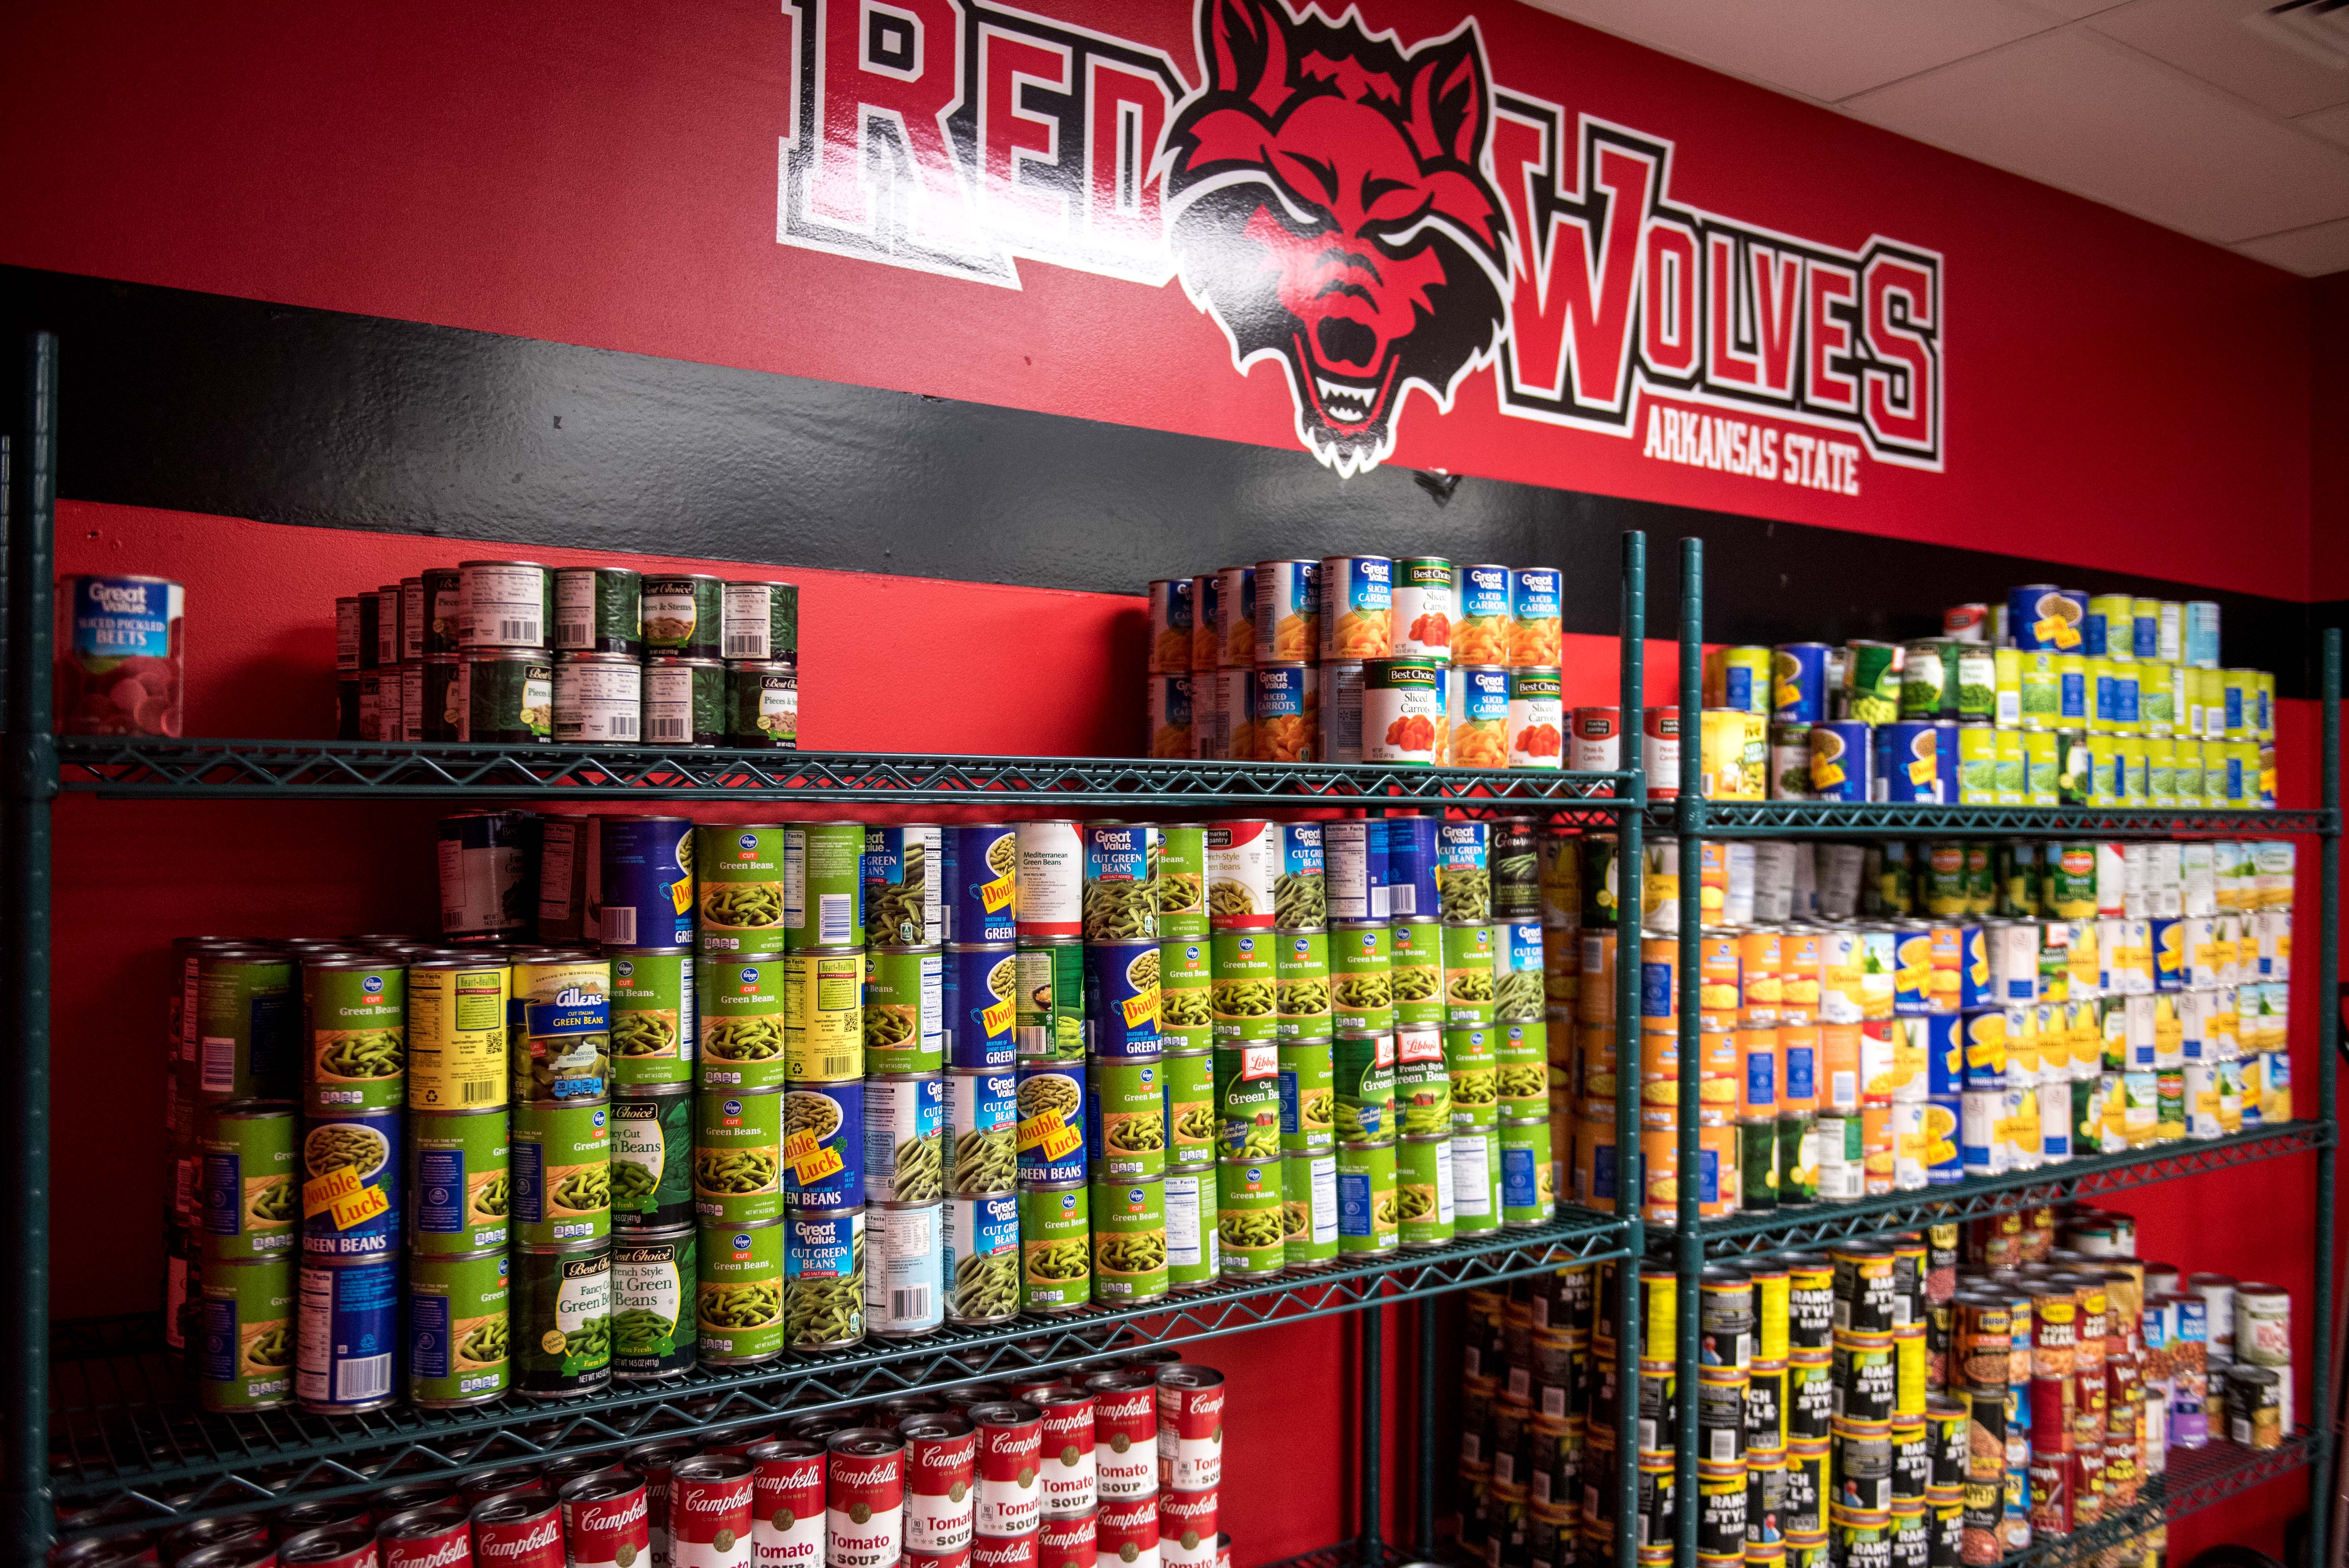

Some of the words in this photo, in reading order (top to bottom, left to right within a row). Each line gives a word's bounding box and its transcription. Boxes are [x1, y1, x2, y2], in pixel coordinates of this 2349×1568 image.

[778, 0, 1174, 289] RED
[1488, 87, 1944, 471] WOLVES
[1644, 404, 1777, 480] ARKANSAS
[1783, 433, 1859, 496] STATE
[1413, 570, 1431, 579] Best
[1471, 571, 1502, 582] Great
[1522, 574, 1552, 586] Great
[659, 582, 692, 594] Choice
[1479, 580, 1502, 590] Value
[1530, 583, 1552, 592] Value
[89, 583, 147, 604] Great
[1426, 591, 1446, 601] Sliced
[1477, 593, 1501, 601] SLICED
[1528, 595, 1552, 604] SLICED
[103, 602, 147, 614] Value
[1469, 601, 1506, 610] CARROTS
[1519, 604, 1557, 612] CARROTS
[96, 630, 147, 646] BEETS
[529, 668, 547, 678] Best
[1391, 670, 1411, 679] Best
[1412, 670, 1434, 681] Choice
[766, 677, 786, 688] Best
[1519, 682, 1538, 691] Best
[1539, 683, 1560, 691] Choice
[528, 688, 546, 698] Pieces
[1405, 693, 1428, 702] Sliced
[764, 696, 785, 704] Pieces
[1401, 704, 1430, 713] Carrots
[1528, 713, 1556, 722] Carrots
[1095, 830, 1131, 842] Great
[1294, 828, 1320, 839] Great
[1442, 826, 1474, 838] Great
[741, 838, 756, 847] Kroger
[1302, 838, 1321, 847] Value
[1450, 836, 1475, 844] Value
[1103, 842, 1131, 850] Value
[1092, 854, 1109, 863] CUT
[1111, 854, 1141, 863] GREEN
[1102, 864, 1132, 872] BEANS
[985, 928, 1012, 939] GREEN
[822, 961, 835, 971] Heart
[838, 960, 854, 973] Healthy
[536, 974, 558, 982] SERVING
[365, 980, 382, 990] Kroger
[340, 1007, 373, 1016] Green
[375, 1005, 400, 1015] Beans
[553, 1018, 581, 1026] GREEN
[584, 1017, 603, 1025] BEANS
[1407, 1040, 1436, 1054] Libby's
[1251, 1055, 1276, 1071] Libby's
[1399, 1063, 1427, 1073] French
[988, 1078, 1015, 1090] Great
[1259, 1081, 1271, 1090] Cut
[997, 1088, 1015, 1098] Value
[1229, 1093, 1266, 1105] Green
[617, 1106, 653, 1118] Choice
[706, 1128, 732, 1136] Green
[734, 1127, 761, 1136] Beans
[620, 1141, 661, 1152] Beans
[1044, 1131, 1080, 1157] Luck
[795, 1151, 836, 1181] Luck
[1051, 1165, 1081, 1179] BEANS
[803, 1192, 841, 1205] BEANS
[334, 1192, 385, 1226] Luck
[1139, 1211, 1159, 1220] Beans
[795, 1222, 835, 1236] Great
[1045, 1220, 1069, 1229] Green
[341, 1235, 387, 1252] BEANS
[735, 1238, 750, 1246] Kroger
[804, 1234, 835, 1244] Value
[633, 1251, 669, 1262] Choice
[791, 1248, 811, 1258] CUT
[813, 1246, 847, 1257] GREEN
[714, 1262, 741, 1270] Green
[744, 1260, 769, 1269] Beans
[802, 1258, 835, 1269] BEANS
[569, 1262, 598, 1277] Best
[641, 1267, 664, 1276] Style
[581, 1284, 603, 1296] Fancy
[629, 1278, 672, 1291] Green
[559, 1298, 599, 1313] Green
[615, 1294, 657, 1306] Beans
[645, 1358, 659, 1367] (411g)
[1042, 1476, 1093, 1493] Tomato
[1051, 1495, 1089, 1508] SOUP
[702, 1511, 745, 1522] CONDENSED
[831, 1532, 889, 1549] Tomato
[936, 1530, 970, 1546] SOUP
[753, 1542, 813, 1559] Tomato
[837, 1554, 880, 1565] SOUP
